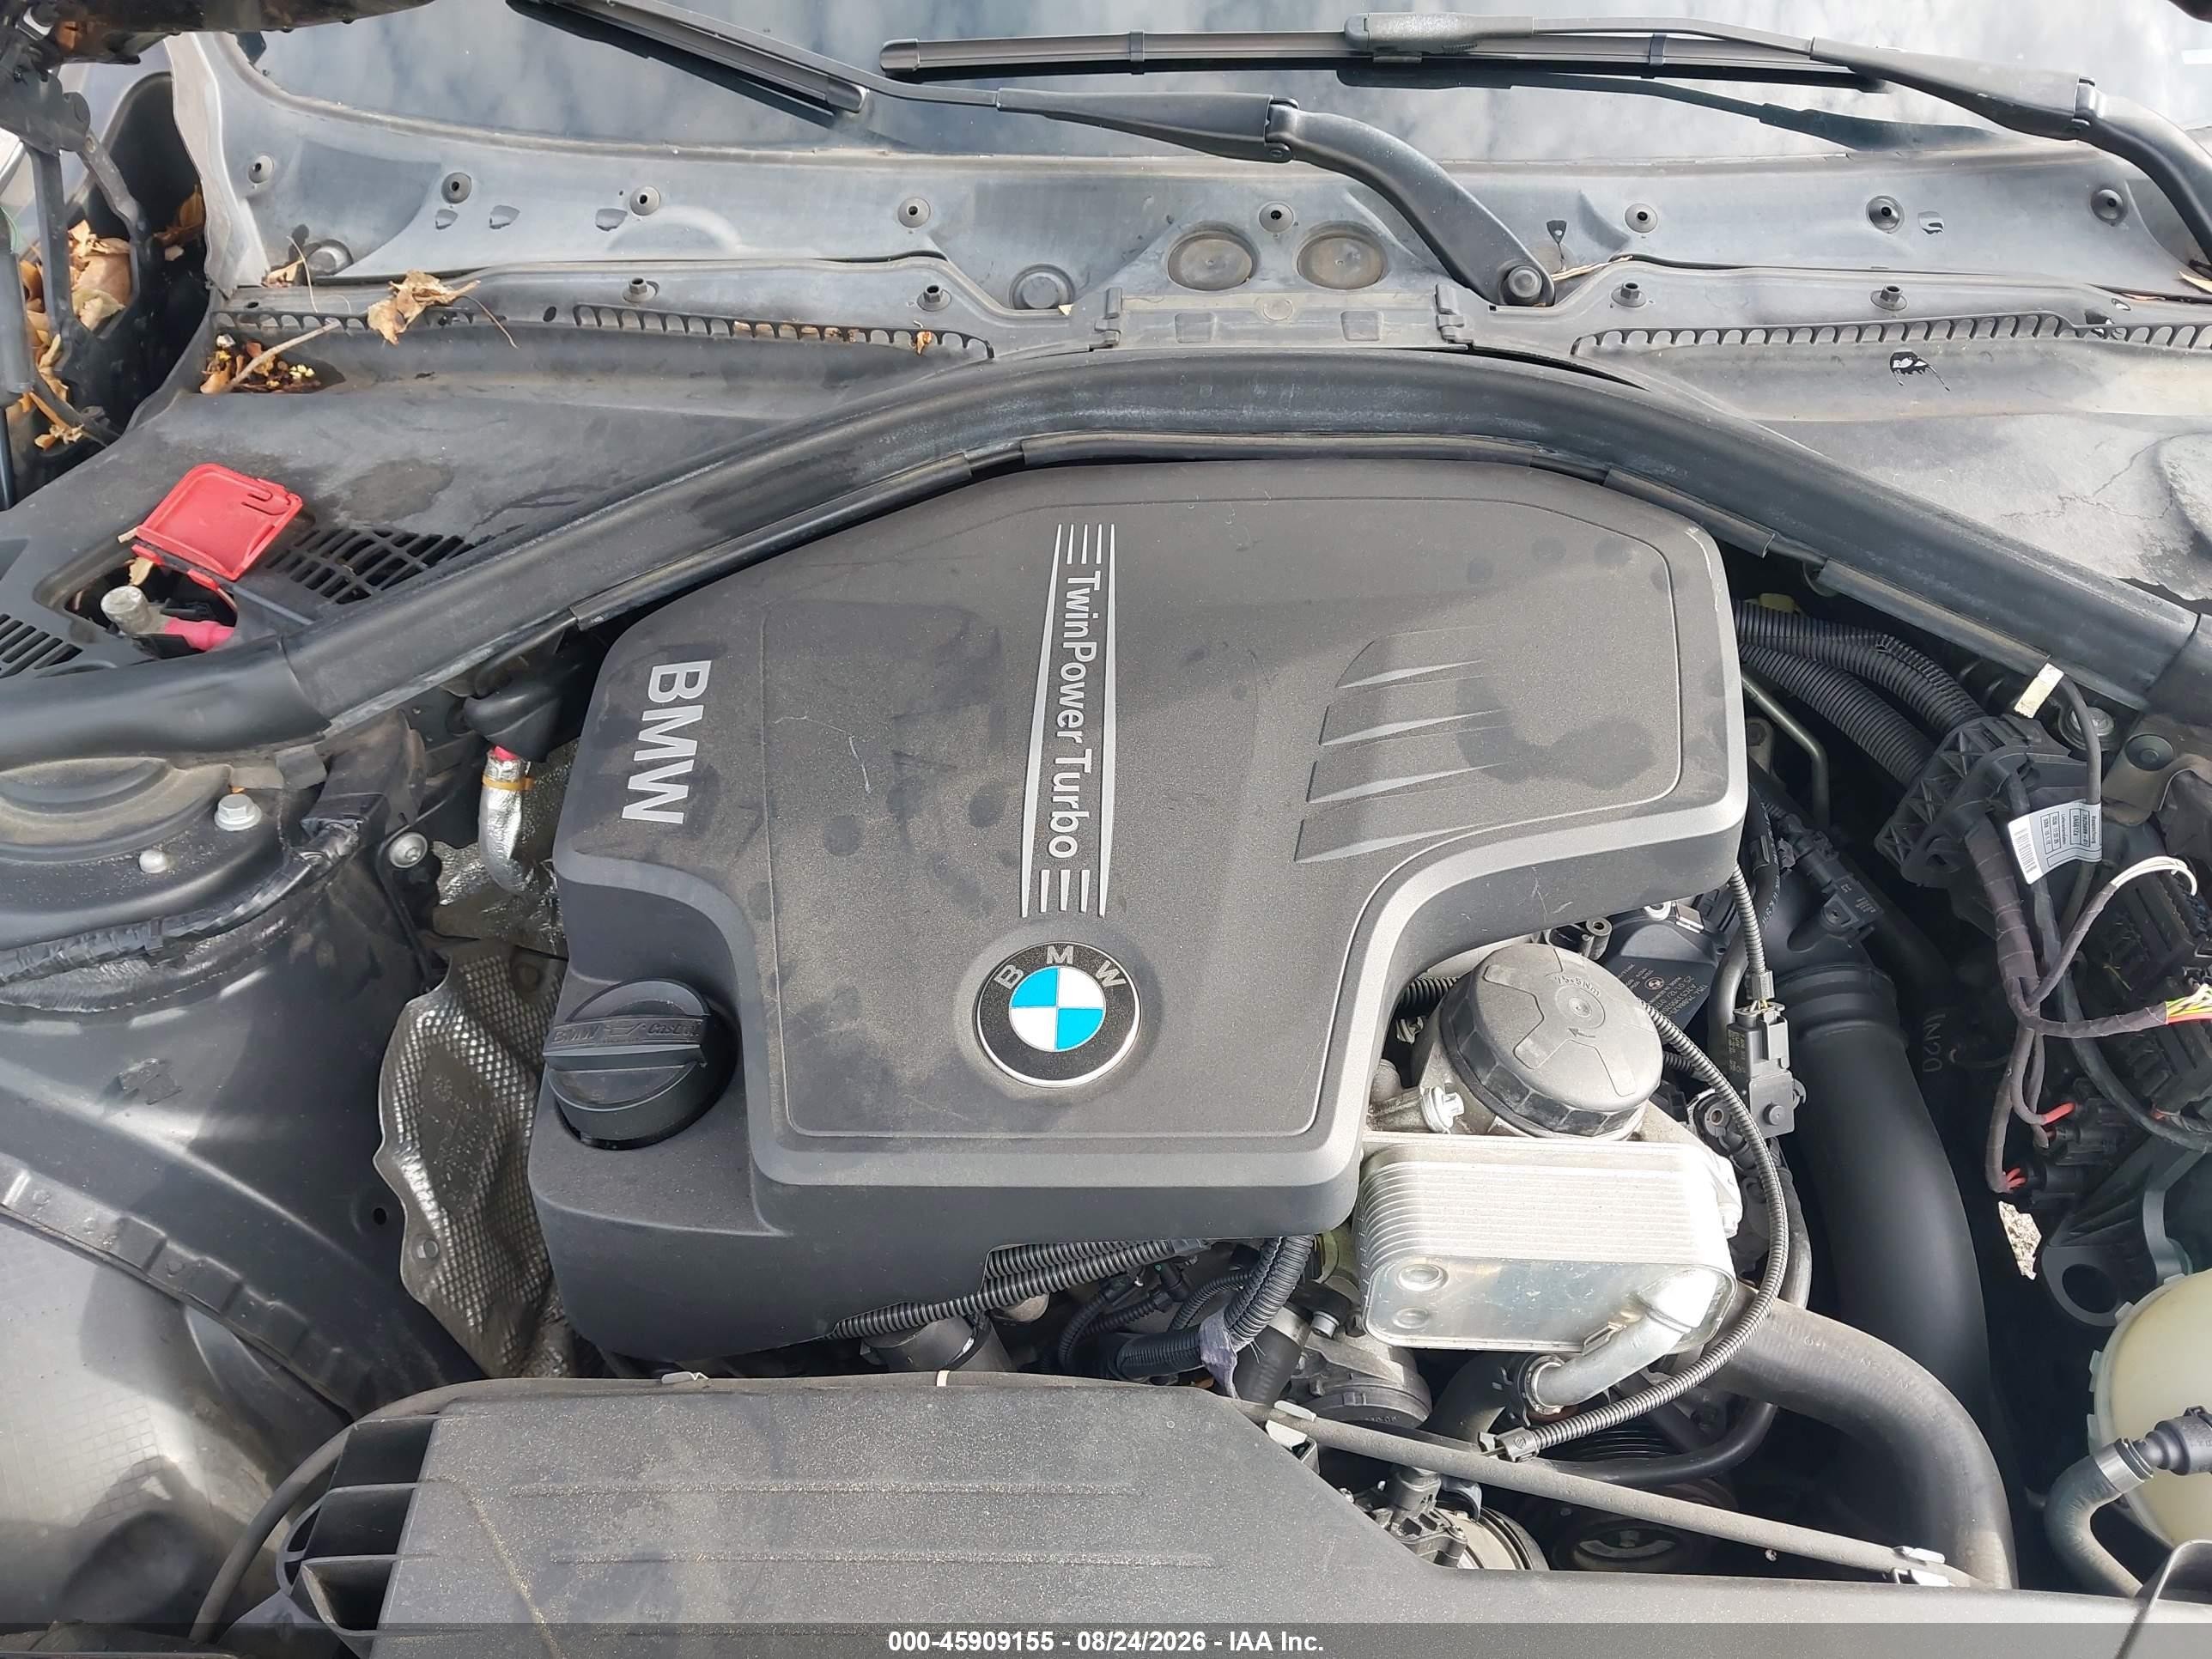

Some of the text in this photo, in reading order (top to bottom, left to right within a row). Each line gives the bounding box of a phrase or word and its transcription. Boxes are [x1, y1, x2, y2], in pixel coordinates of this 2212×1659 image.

[622, 660, 712, 824] BMW
[1048, 570, 1102, 859] TwinPower Turbo
[994, 945, 1127, 989] BMW
